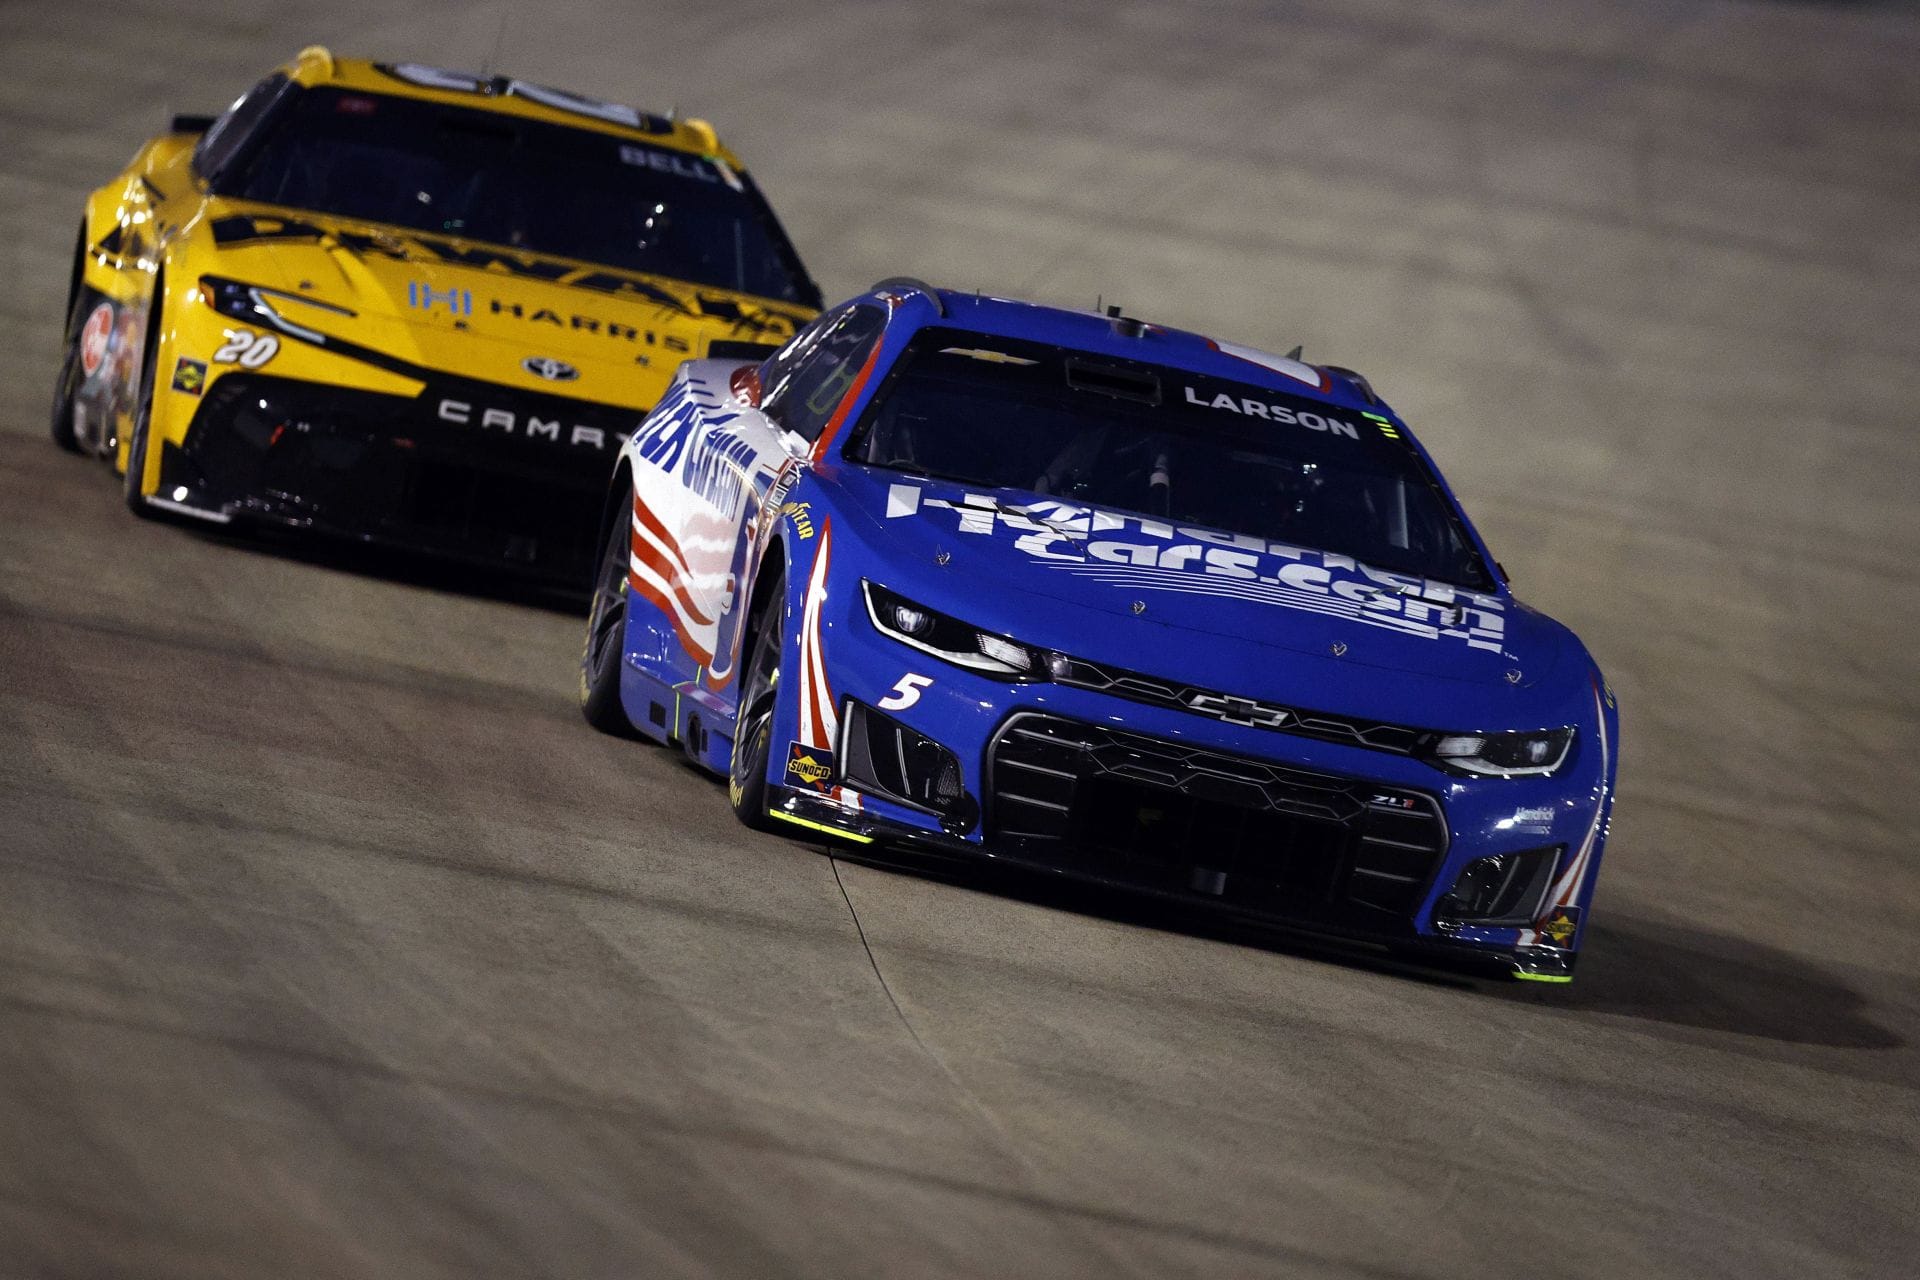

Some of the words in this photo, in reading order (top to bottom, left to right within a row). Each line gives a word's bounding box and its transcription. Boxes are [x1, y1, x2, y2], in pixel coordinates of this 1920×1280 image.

[621, 144, 719, 183] BELL
[490, 299, 690, 353] HARRIS
[213, 329, 279, 369] 20
[1184, 386, 1361, 441] LARSON
[877, 672, 934, 711] 5
[788, 758, 832, 780] SUNOCO
